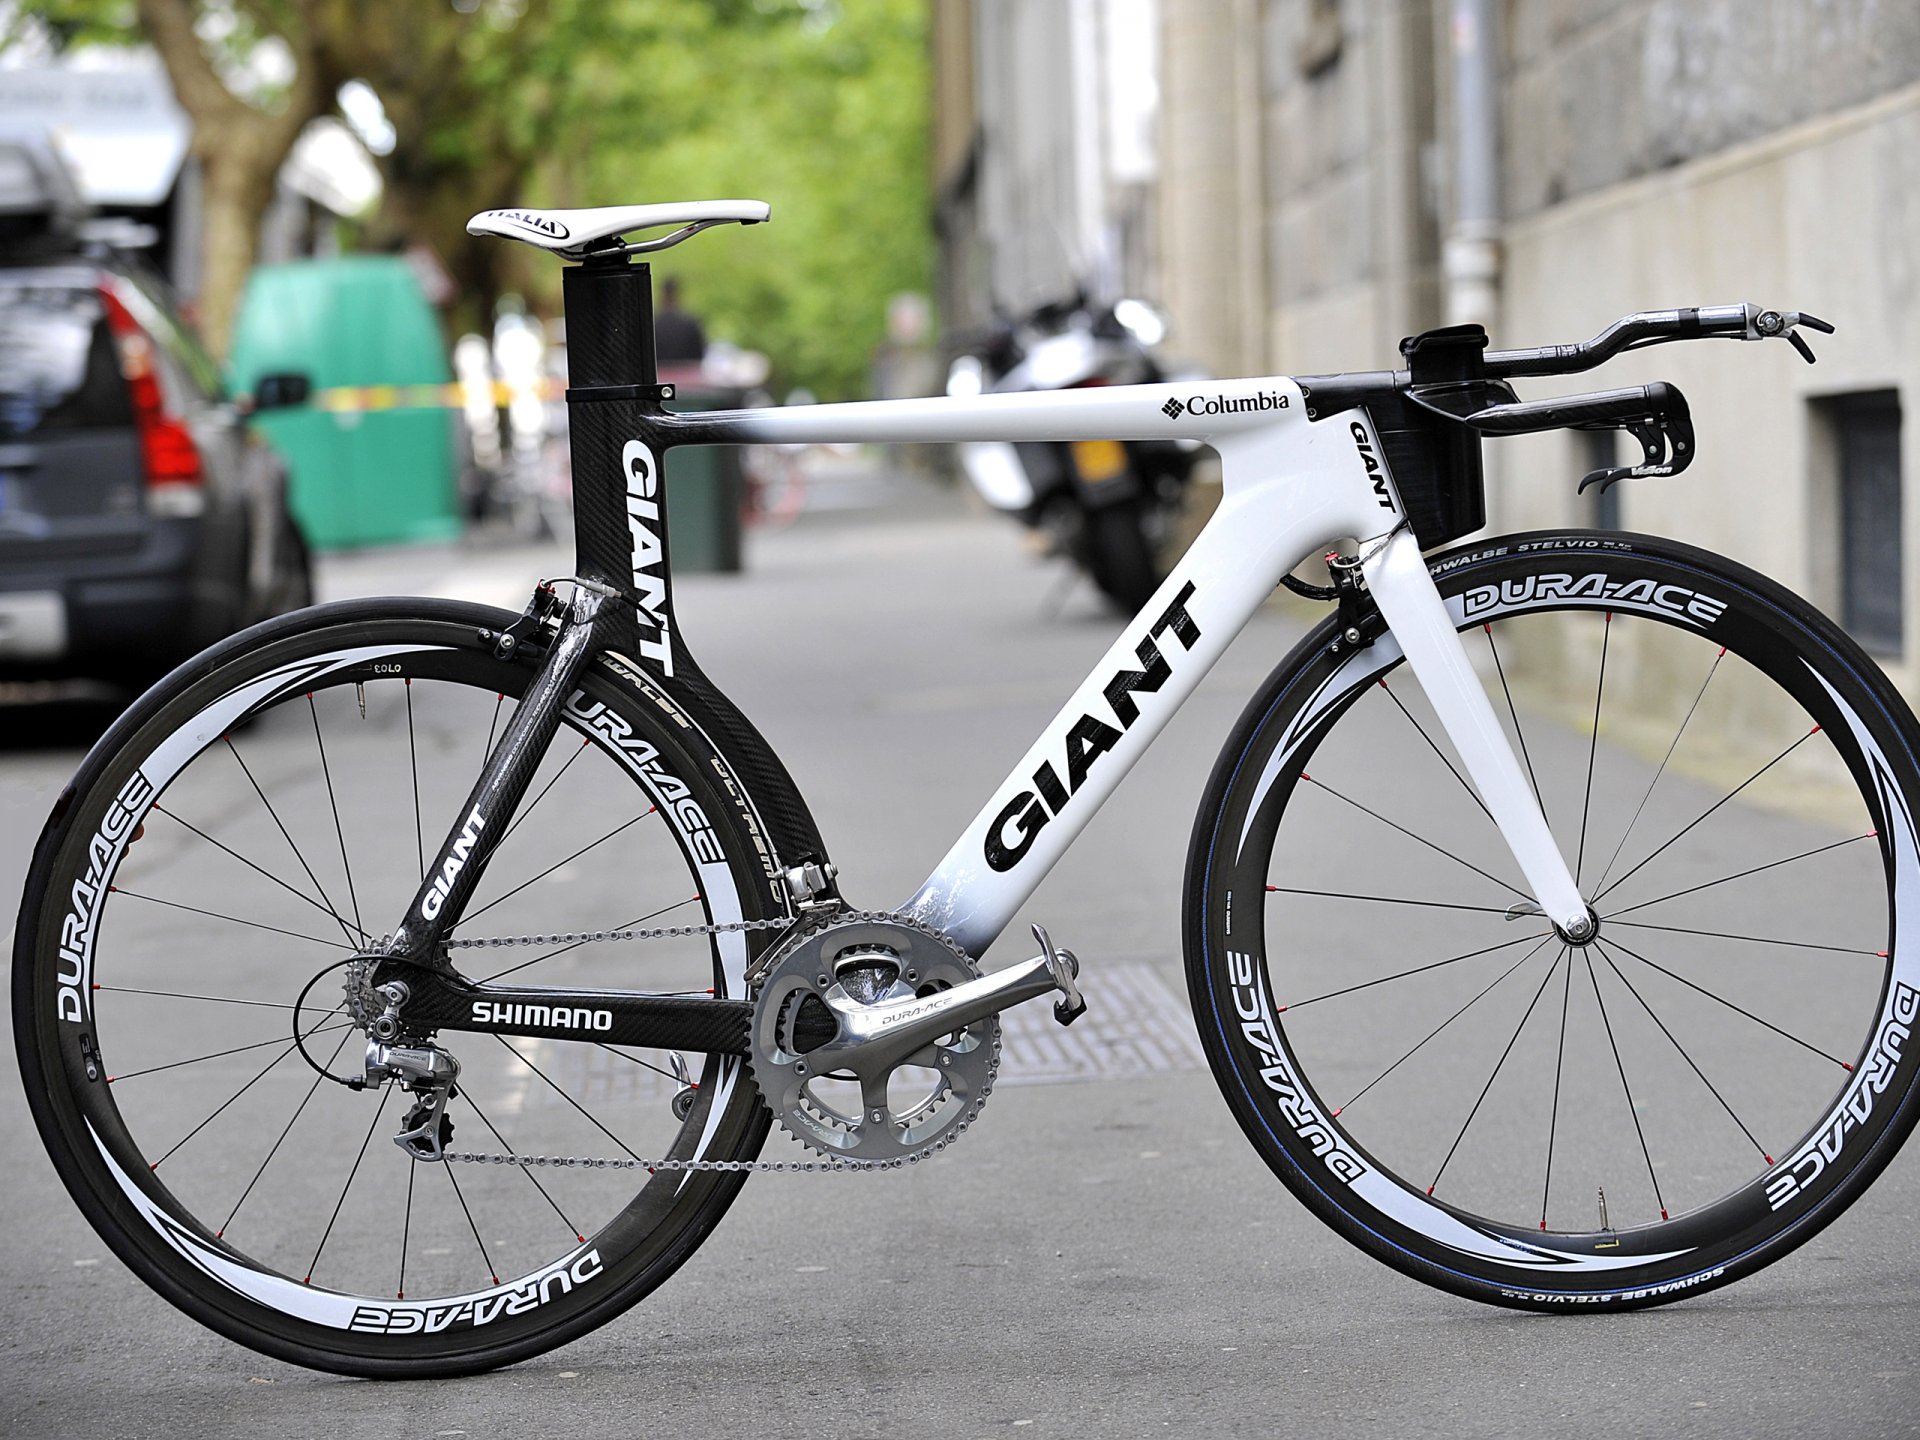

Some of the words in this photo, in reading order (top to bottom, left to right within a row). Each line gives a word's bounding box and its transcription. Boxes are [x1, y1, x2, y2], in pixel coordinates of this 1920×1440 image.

[1186, 390, 1290, 416] Columbia
[1349, 421, 1397, 514] GIANT
[622, 439, 674, 678] GIANT
[1429, 546, 1509, 576] HWALBE
[1517, 540, 1599, 552] STELVIO
[1466, 573, 1729, 624] DURA-ACE
[984, 579, 1202, 874] GIANT
[566, 688, 727, 863] URA-ACE
[57, 770, 151, 1023] DURA-ACE
[421, 802, 486, 921] GIANT
[472, 1001, 613, 1031] SHIMANO
[882, 997, 953, 1025] DURA-ACE
[1227, 951, 1365, 1184] DURA-ACE
[1765, 984, 1920, 1212] DURA-ACE
[351, 1248, 604, 1335] DURA-ACE
[1533, 1293, 1612, 1304] STELVIO
[1621, 1266, 1725, 1301] SCHWALBE
